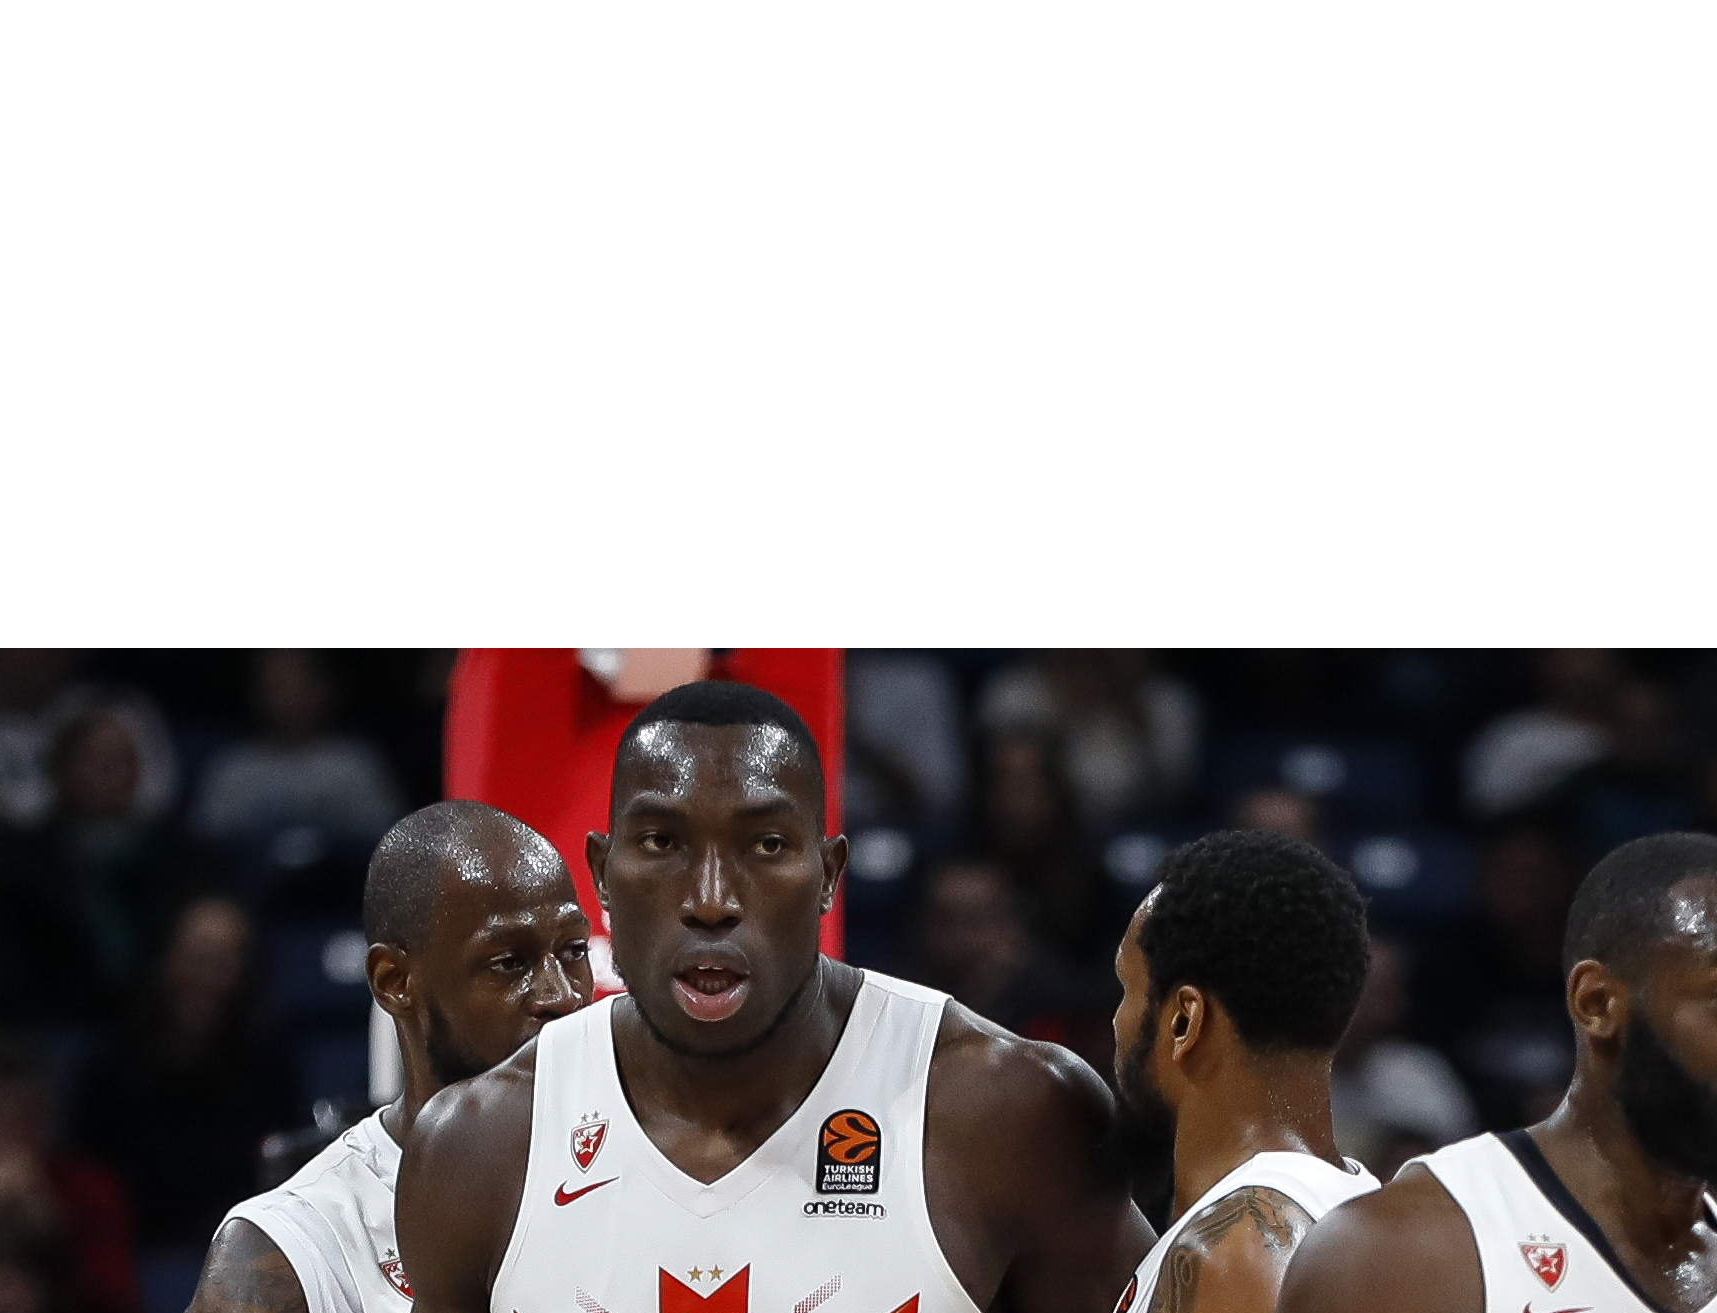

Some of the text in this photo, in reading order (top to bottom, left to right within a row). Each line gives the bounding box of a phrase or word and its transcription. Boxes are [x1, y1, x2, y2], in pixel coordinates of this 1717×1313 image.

[824, 1165, 875, 1174] TURKISH
[823, 1174, 874, 1183] AIRLINES
[804, 1199, 884, 1216] oneteam
